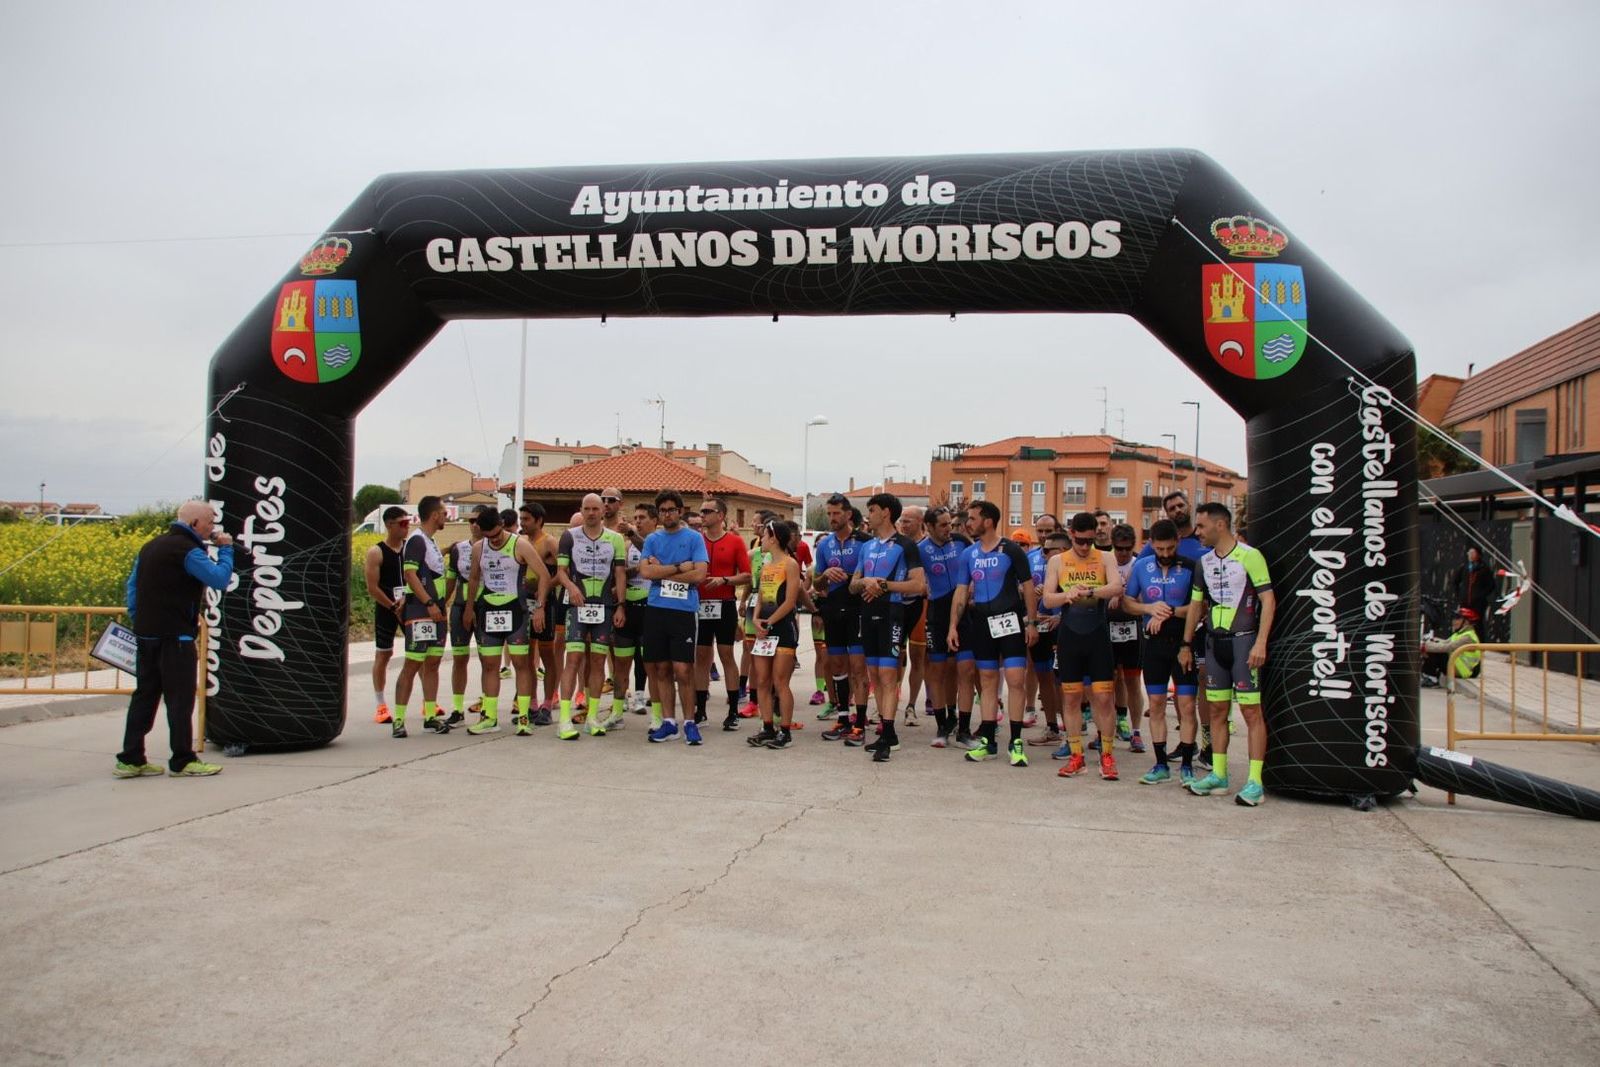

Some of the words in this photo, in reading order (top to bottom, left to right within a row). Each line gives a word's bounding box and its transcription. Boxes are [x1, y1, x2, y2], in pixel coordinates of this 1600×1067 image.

[571, 180, 889, 224] Ayuntamiento
[900, 175, 956, 206] de
[427, 230, 759, 272] CASTELLANOS
[772, 228, 838, 264] DE
[851, 220, 1122, 263] MORISCOS
[206, 431, 227, 482] de
[1309, 442, 1336, 495] con
[1362, 385, 1399, 567] Castellanos
[1309, 509, 1354, 537] el
[237, 476, 304, 663] Deportes
[974, 556, 998, 569] PINTO
[1068, 570, 1097, 582] NAVAS
[667, 582, 686, 593] 102
[1364, 581, 1399, 621] de
[493, 616, 507, 625] 33
[585, 609, 599, 618] 29
[704, 605, 716, 613] 57
[998, 619, 1014, 629] 12
[1296, 549, 1353, 699] Deporte!!
[891, 625, 902, 643] MSC
[1364, 634, 1396, 768] Moriscos
